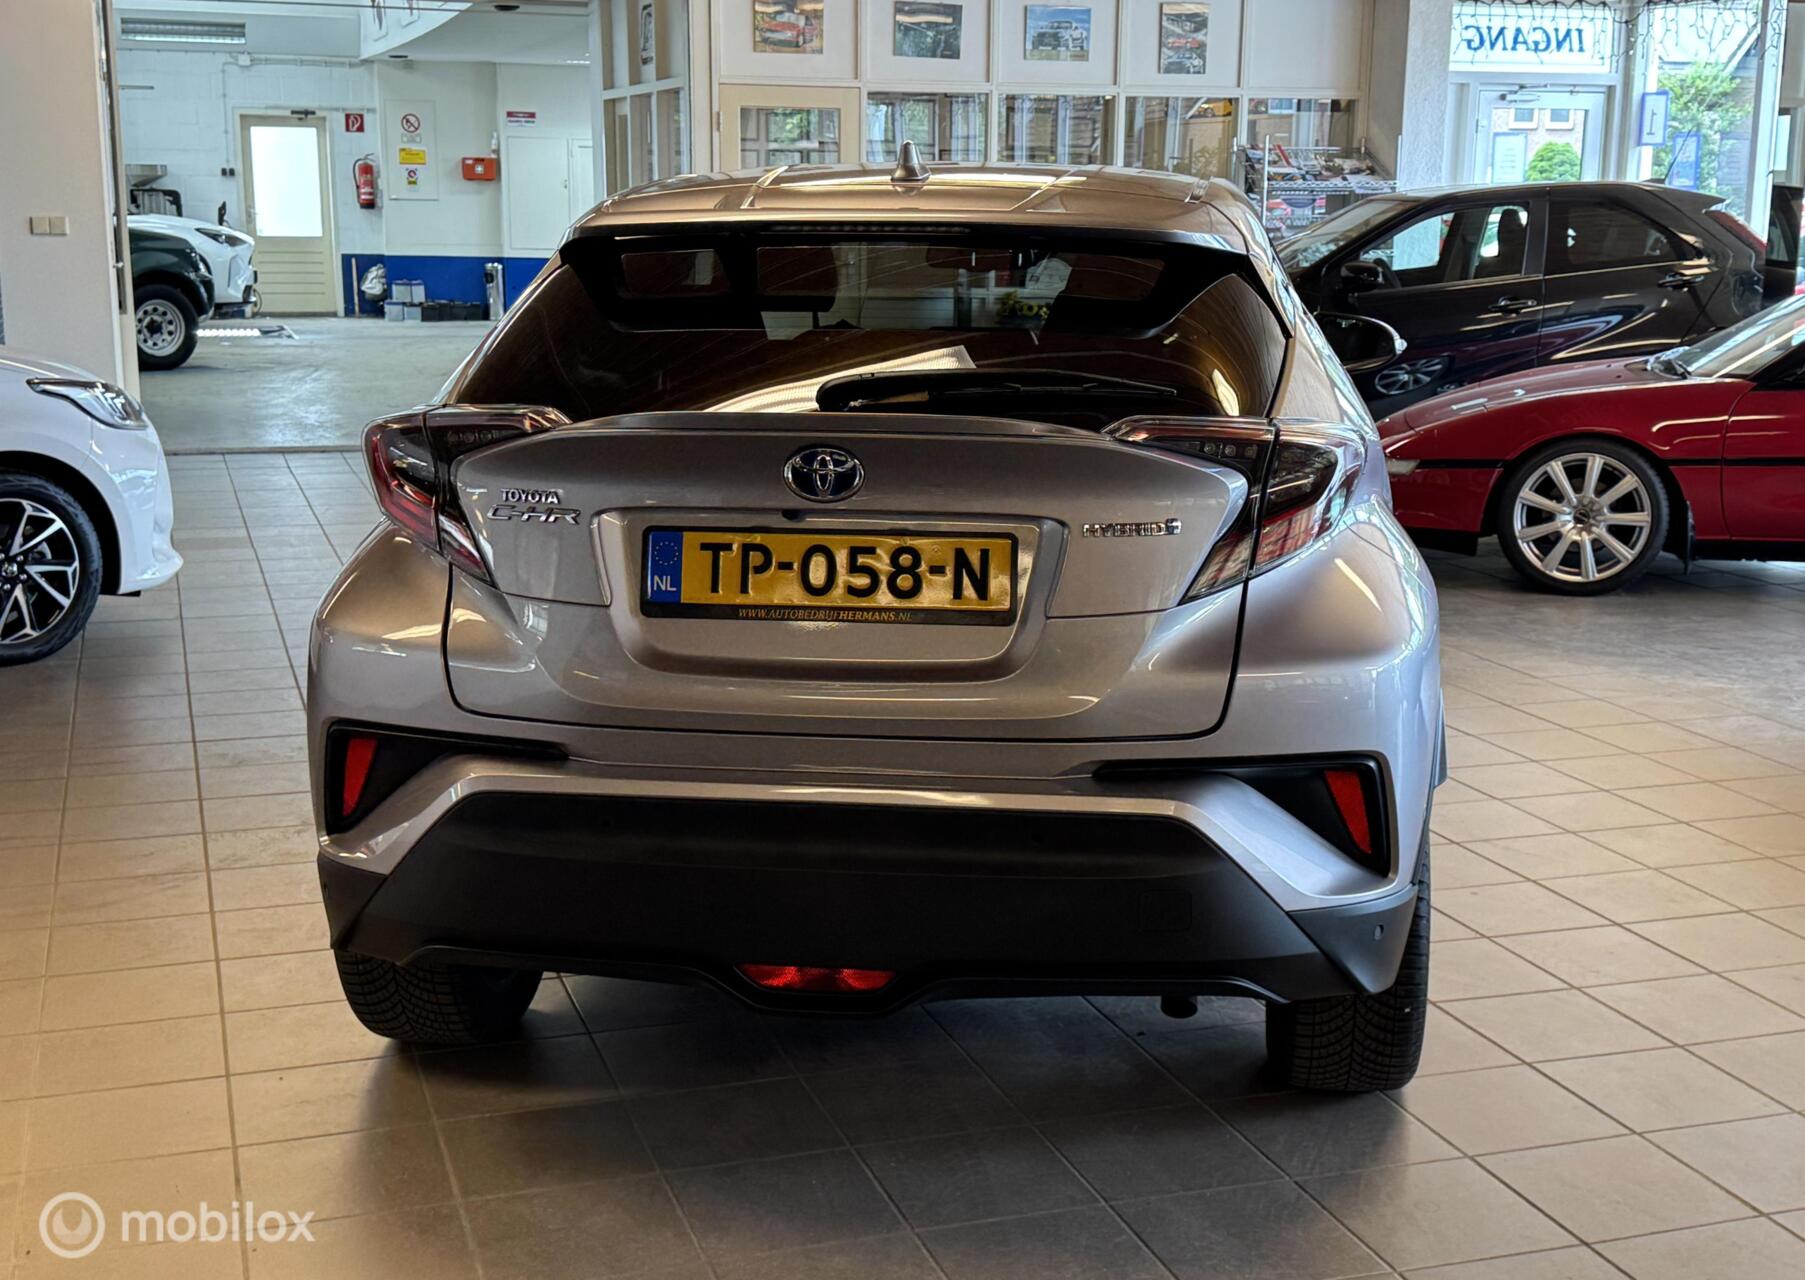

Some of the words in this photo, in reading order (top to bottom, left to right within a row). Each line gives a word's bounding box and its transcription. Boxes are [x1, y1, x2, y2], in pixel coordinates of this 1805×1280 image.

[500, 487, 561, 504] TOYOTA
[487, 504, 581, 525] C-HR
[1083, 523, 1166, 537] HYBRID
[700, 543, 991, 600] TP-058-N
[653, 575, 677, 591] NL
